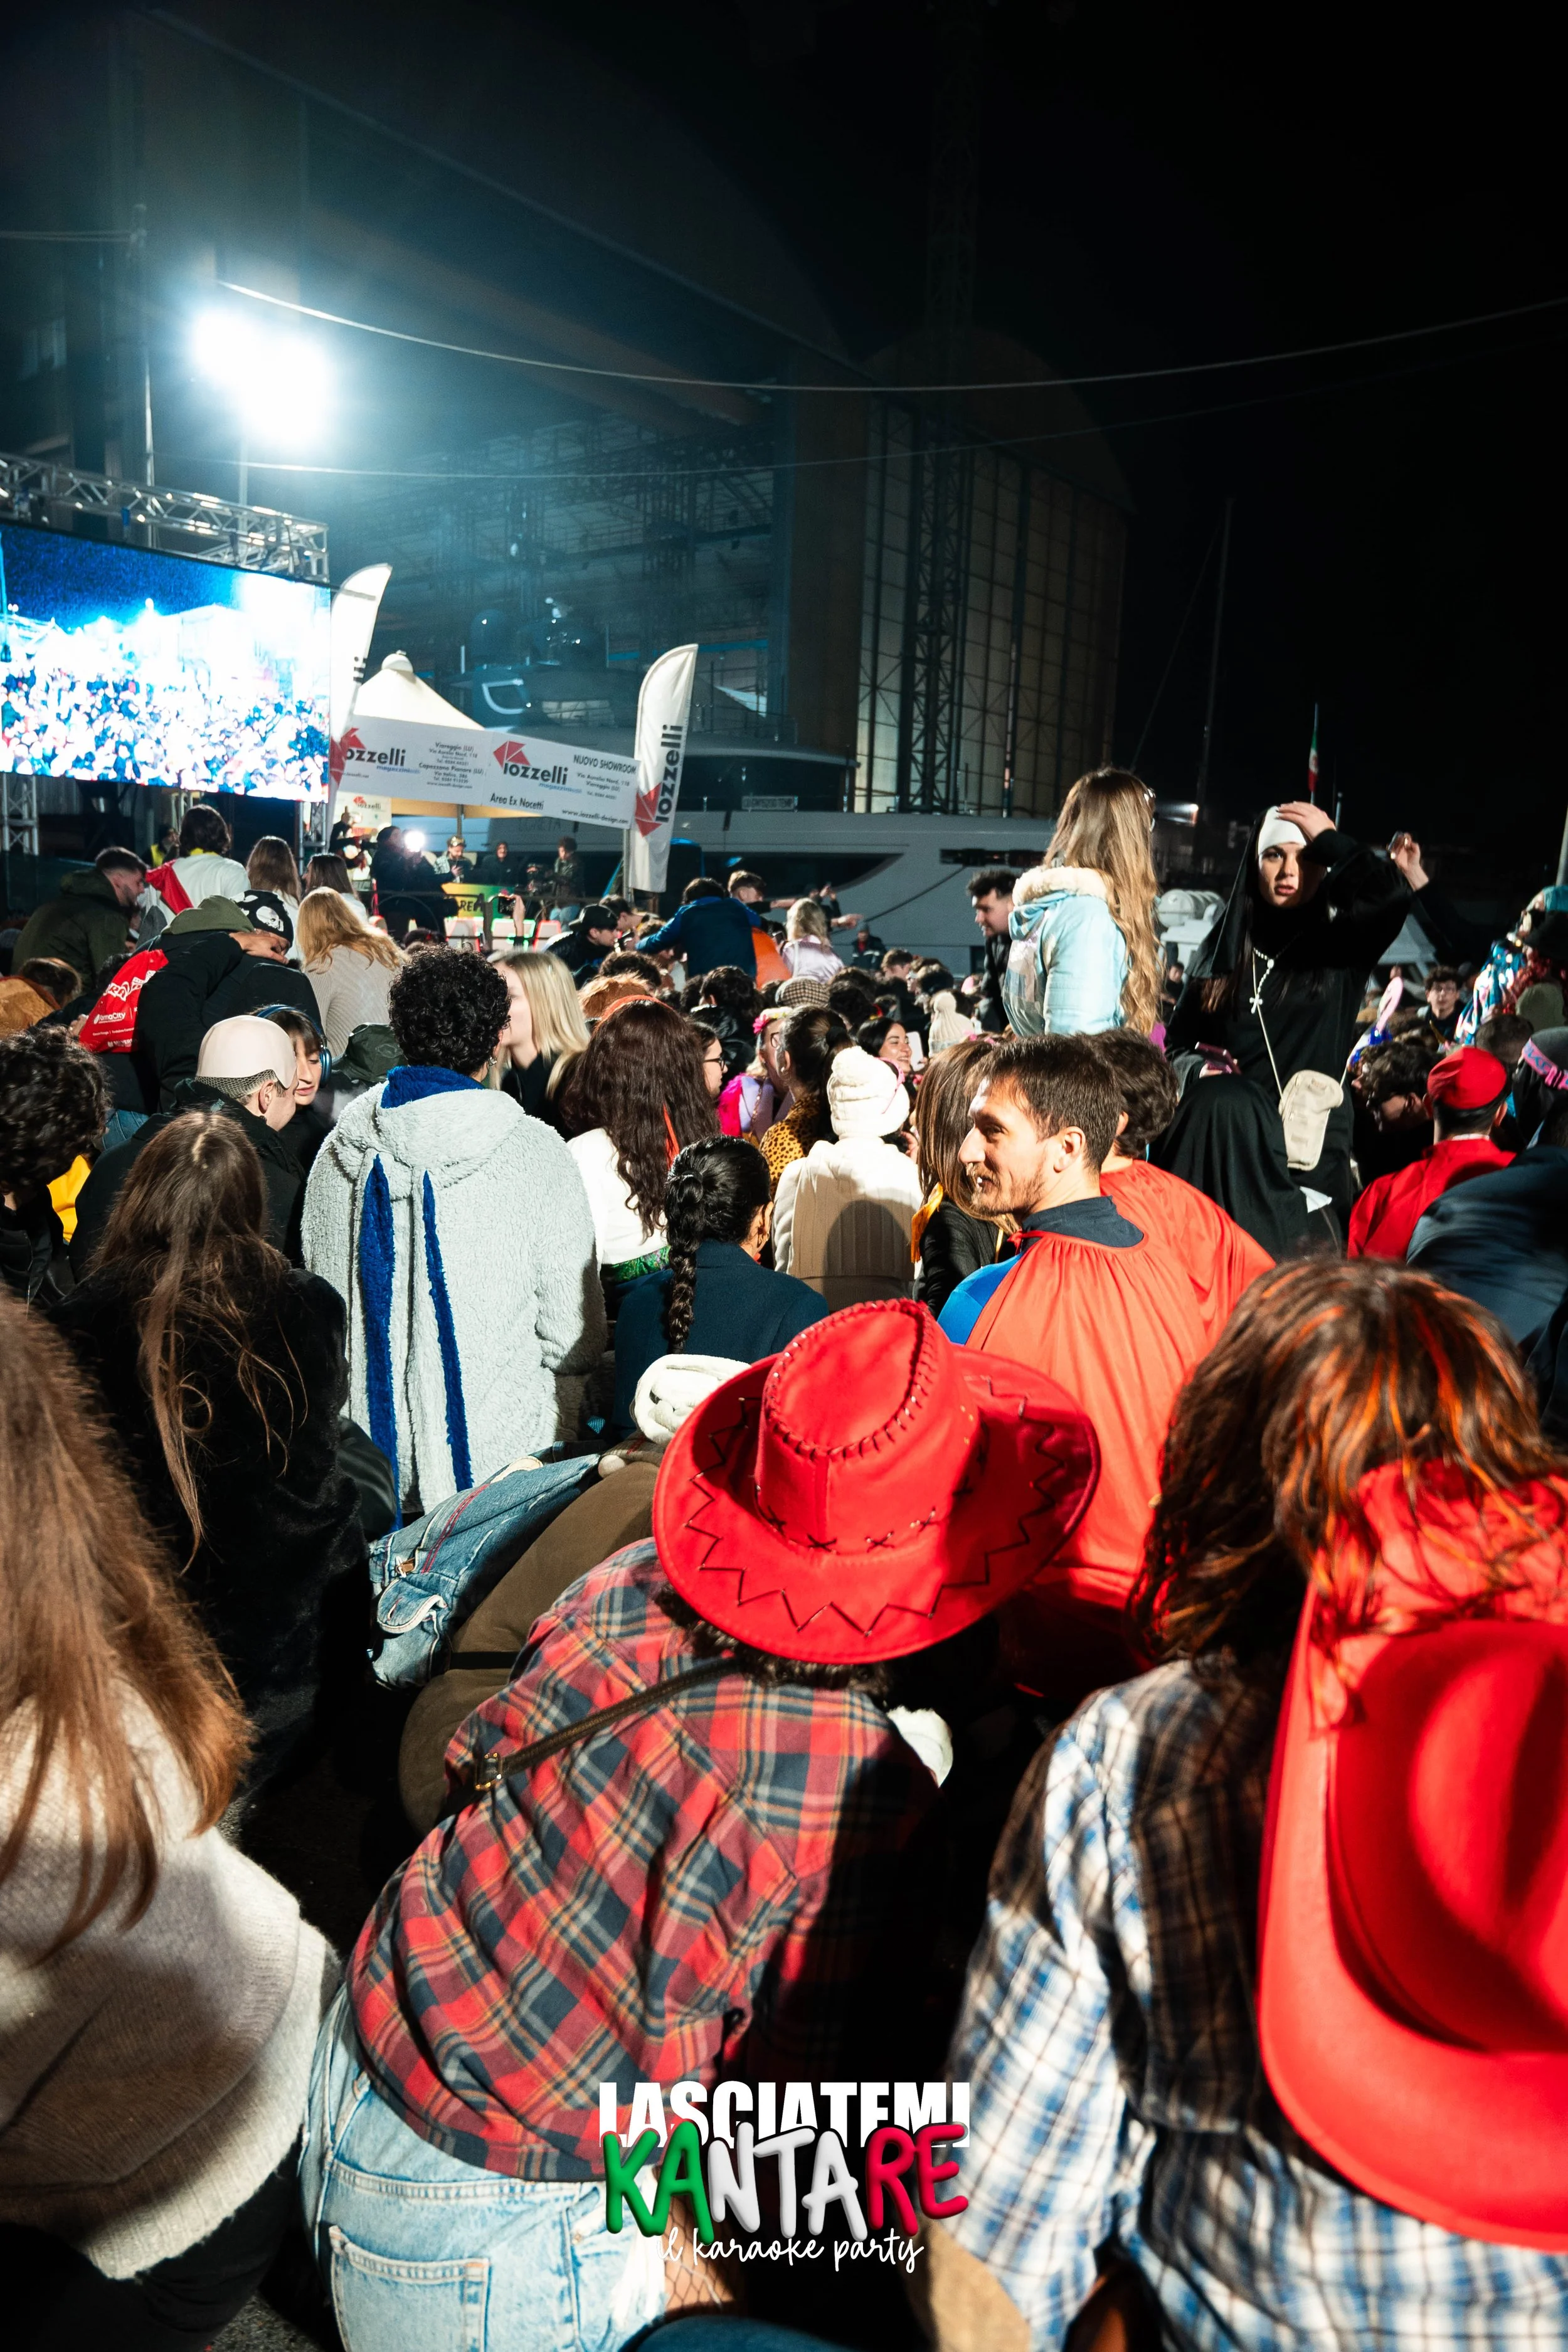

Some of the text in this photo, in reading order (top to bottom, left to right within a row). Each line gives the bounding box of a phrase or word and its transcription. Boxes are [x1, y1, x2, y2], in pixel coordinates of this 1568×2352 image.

[346, 747, 406, 766] ozzelli
[574, 754, 637, 774] NUOVO SHOWROOM
[490, 793, 544, 810] Area Ex Nocetti
